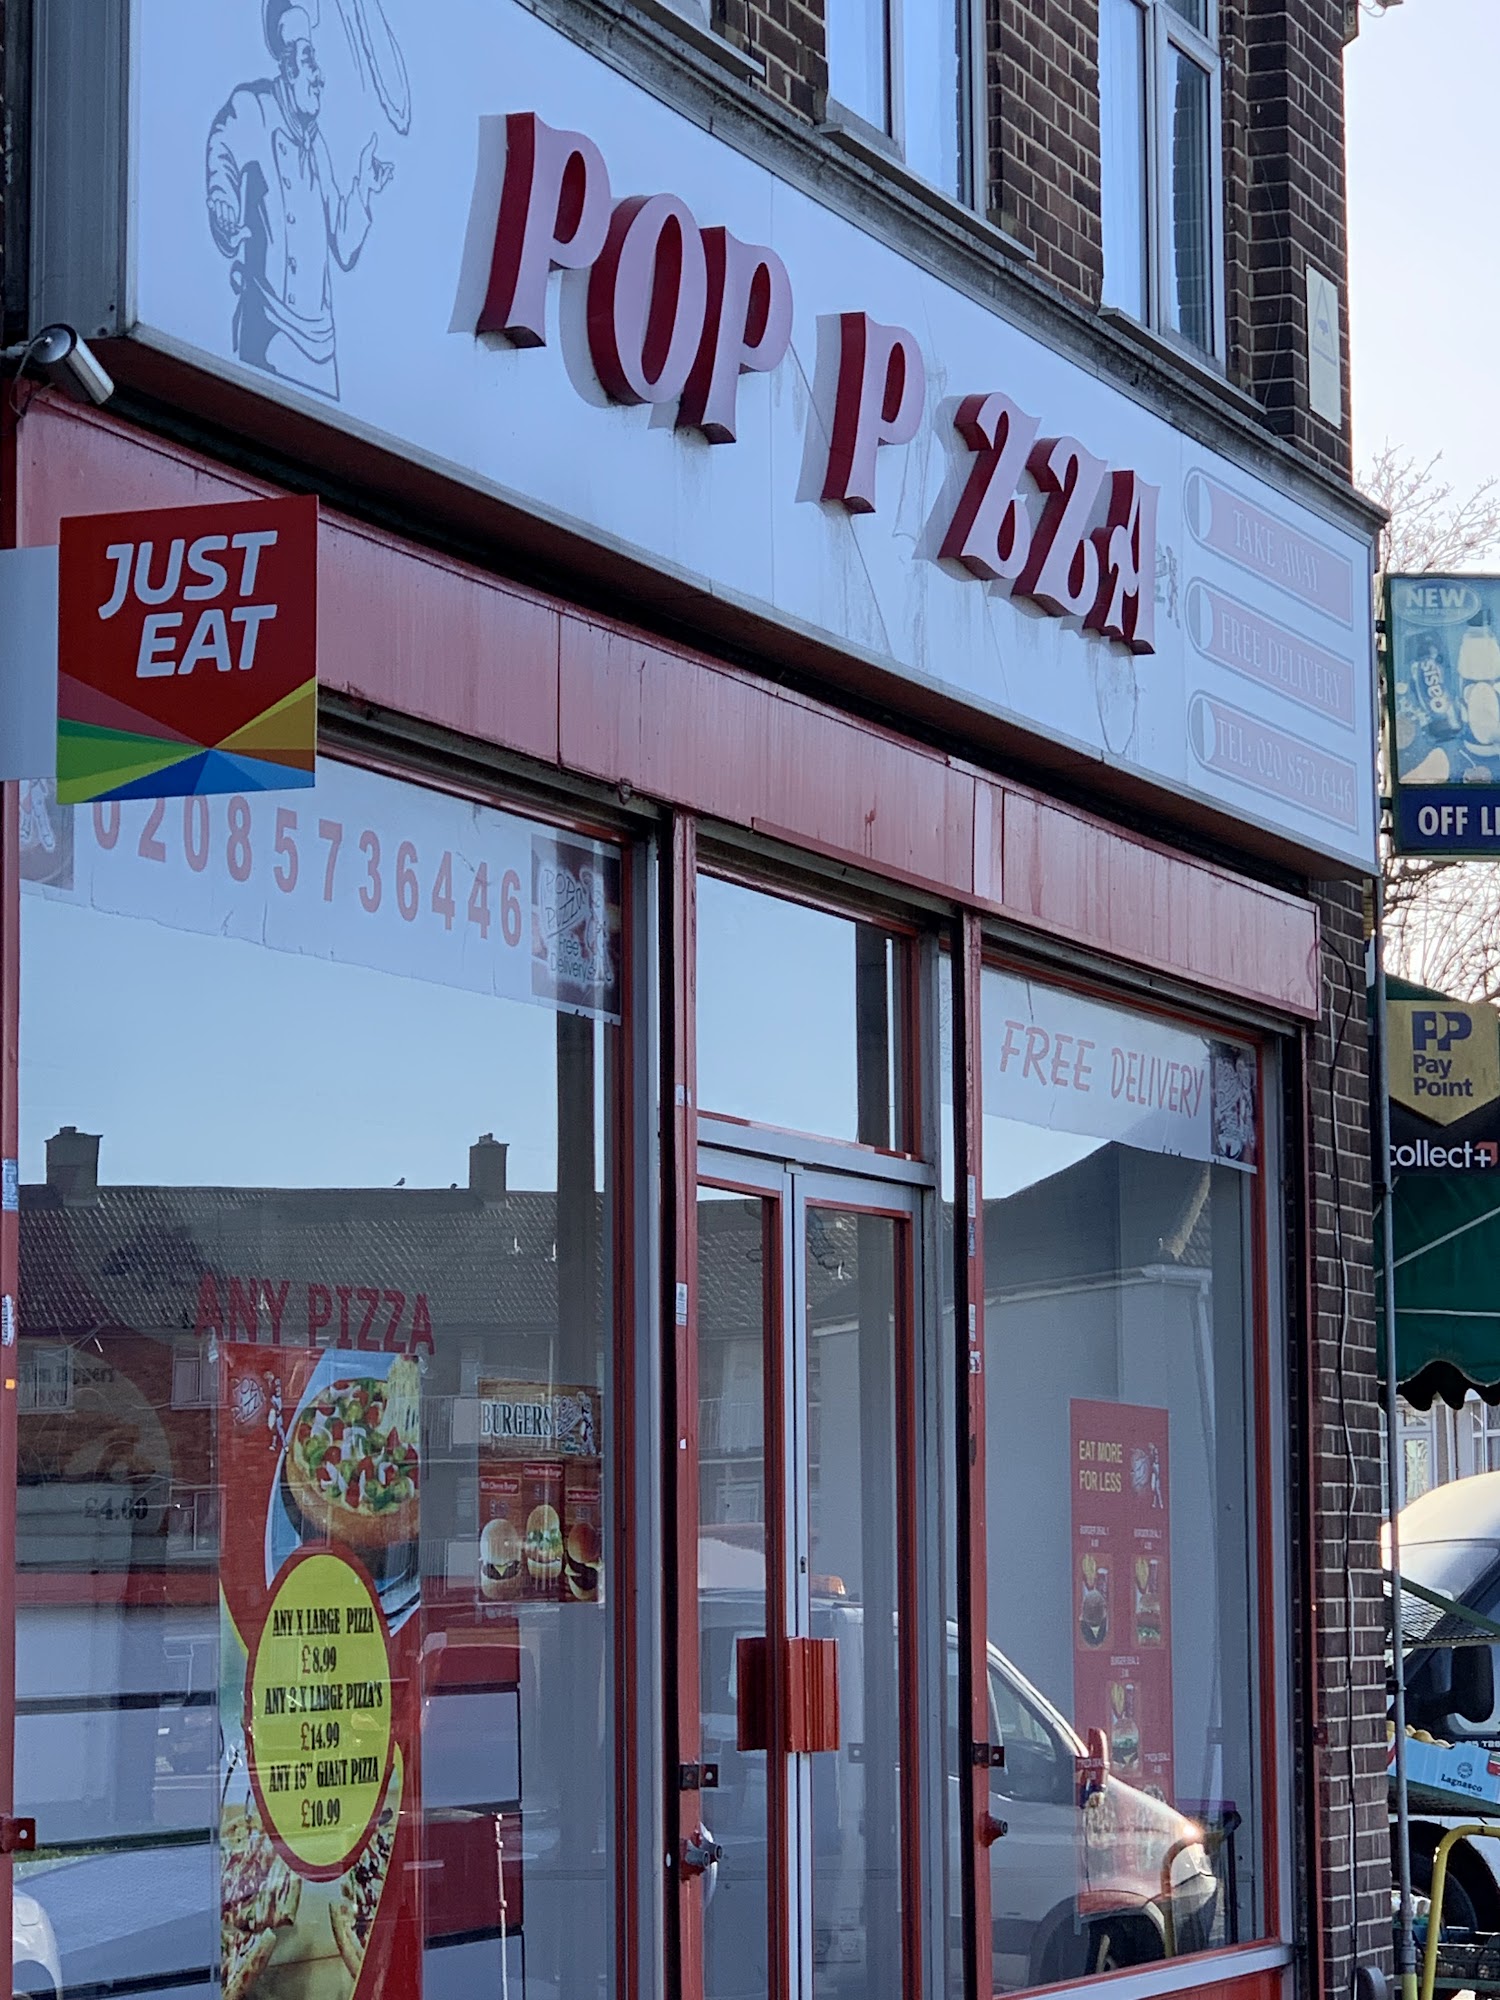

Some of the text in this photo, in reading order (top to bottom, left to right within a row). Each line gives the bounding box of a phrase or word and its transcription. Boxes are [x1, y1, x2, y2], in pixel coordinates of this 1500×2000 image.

[1233, 510, 1319, 593] TAKE AWAY
[98, 530, 278, 620] JUST
[1406, 588, 1466, 608] NEW
[136, 604, 277, 678] EAT
[1221, 611, 1342, 708] FREE DELIVERY
[1256, 738, 1282, 780] 020
[1418, 806, 1467, 836] OFF
[559, 934, 579, 957] Free
[550, 953, 586, 983] Delivery
[999, 1020, 1096, 1092] FREE
[1111, 1047, 1204, 1119] DELIVERY
[1413, 1054, 1452, 1080] Pay
[1414, 1077, 1473, 1097] Point
[196, 1271, 436, 1356] ANY PIZZA
[481, 1401, 553, 1436] BURGERS
[1079, 1440, 1123, 1464] EAT MORE
[1080, 1470, 1122, 1493] FOR LESS
[272, 1607, 373, 1636] ANY X LARGE PIZZA
[302, 1645, 336, 1674] £8.99
[265, 1687, 287, 1715] ANY
[299, 1686, 307, 1713] X
[309, 1685, 343, 1712] LARGE
[301, 1722, 340, 1751] £14.99
[269, 1763, 292, 1792] ANY
[316, 1759, 348, 1786] GIANT
[351, 1756, 379, 1785] PIZZA
[301, 1799, 340, 1828] £10.99
